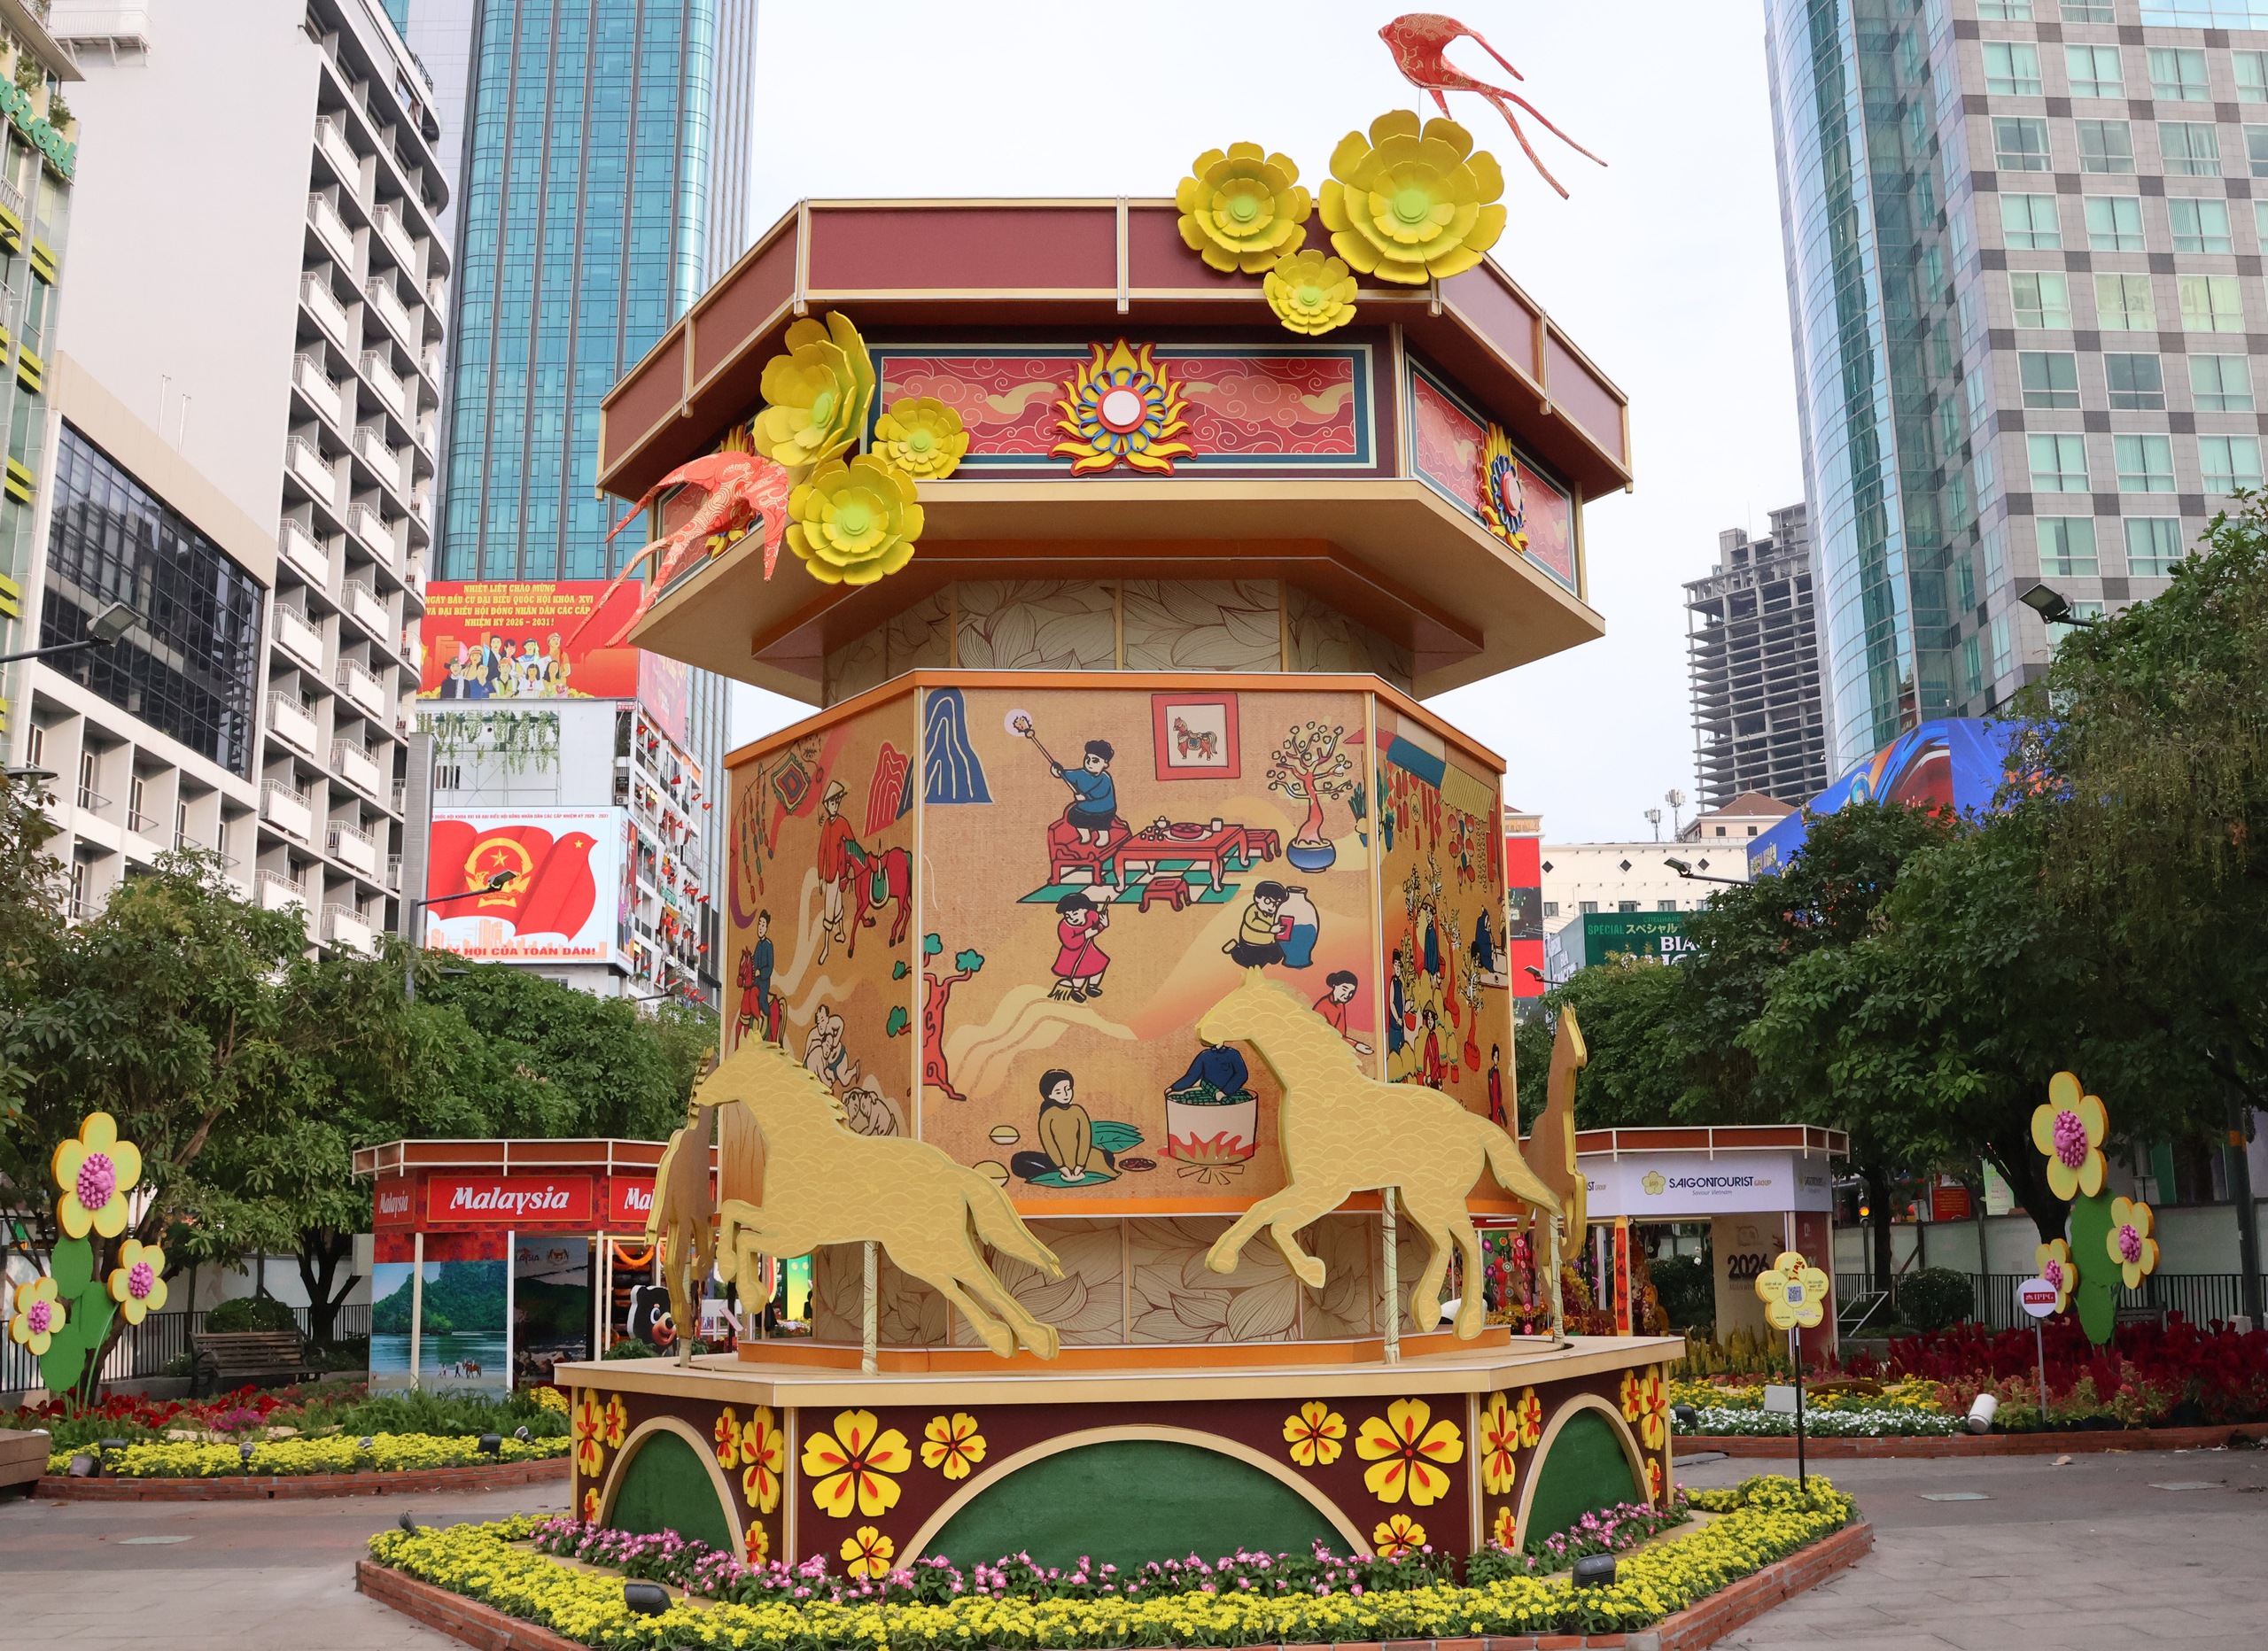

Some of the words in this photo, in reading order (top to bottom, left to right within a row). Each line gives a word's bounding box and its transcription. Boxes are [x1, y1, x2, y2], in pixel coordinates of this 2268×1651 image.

[489, 584, 508, 593] LIỆT
[509, 584, 531, 593] CHÀO
[425, 594, 445, 604] NGÀY
[477, 595, 491, 605] ĐẠI
[513, 594, 534, 605] QUỐC
[536, 594, 551, 605] HỘI
[578, 595, 594, 604] XVI
[426, 606, 437, 616] VÀ
[438, 607, 452, 616] ĐẠI
[474, 606, 489, 616] HỘI
[515, 606, 538, 616] NHÂN
[539, 606, 555, 616] DÂN
[556, 606, 573, 615] CÁC
[574, 604, 591, 615] CẤP
[464, 617, 492, 628] NHIỆM
[493, 617, 505, 627] KỲ
[506, 617, 524, 627] 2026
[1626, 923, 1678, 934] スペシャル
[464, 947, 487, 957] HỘI
[491, 944, 518, 956] CỦA
[523, 945, 558, 956] TOÀN
[1669, 1176, 1754, 1188] SAIGONTOURIST
[378, 1190, 409, 1218] Malaysia
[450, 1186, 570, 1215] Malaysia
[1728, 1253, 1770, 1277] 2026
